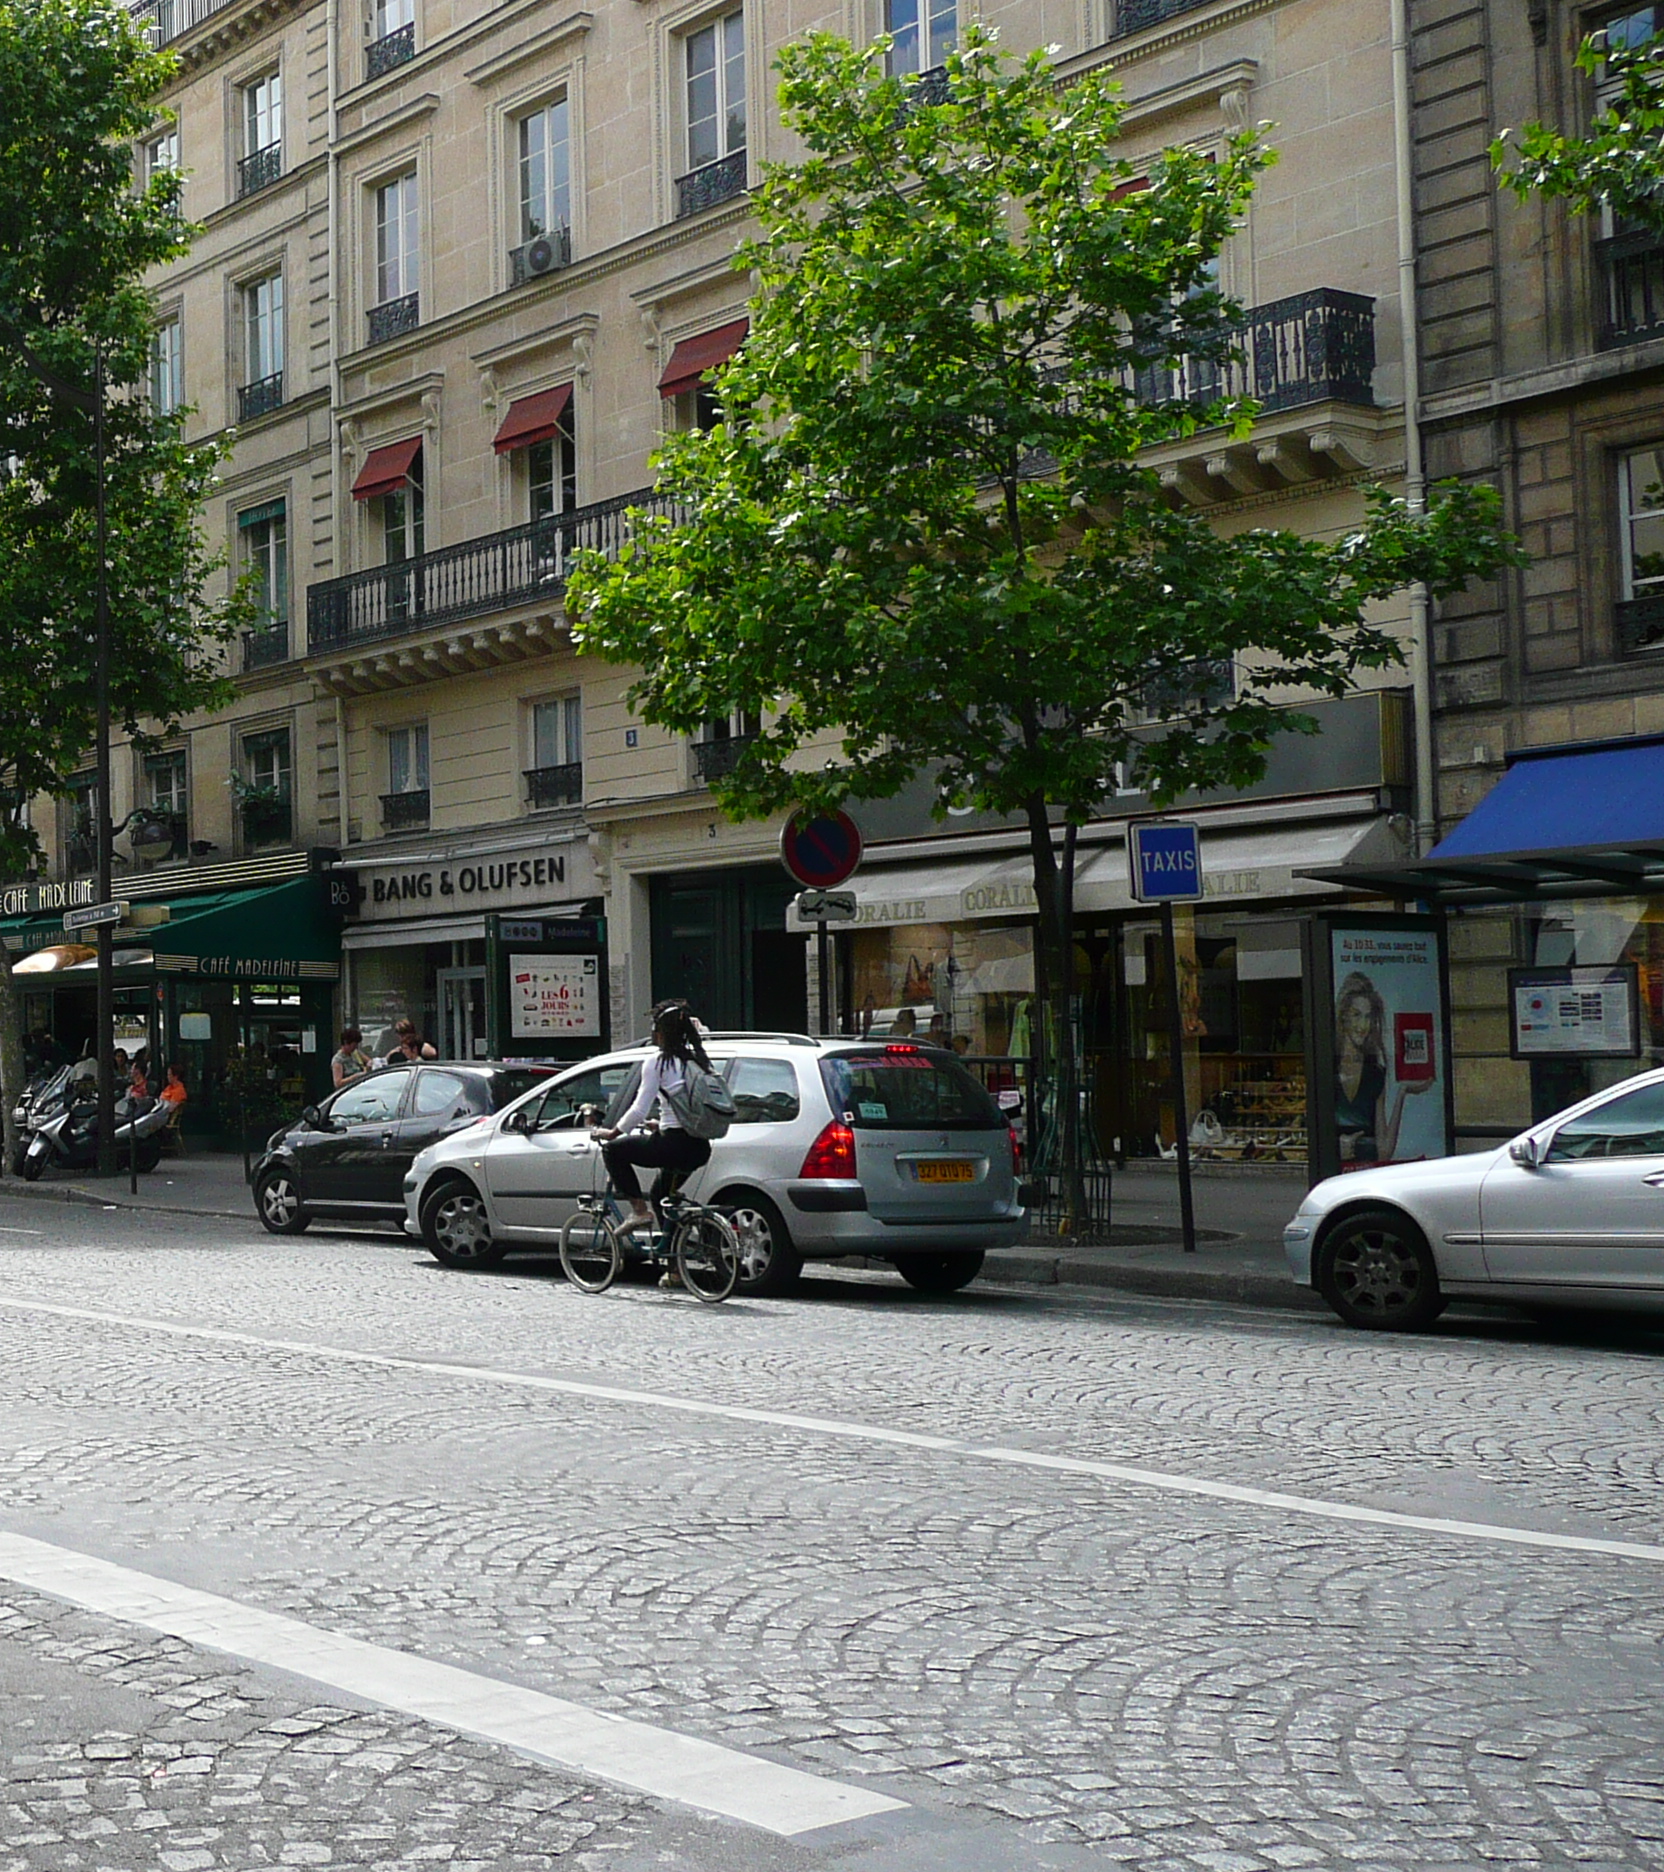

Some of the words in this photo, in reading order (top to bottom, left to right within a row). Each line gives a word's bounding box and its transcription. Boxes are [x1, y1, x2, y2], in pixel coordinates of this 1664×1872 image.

[628, 731, 635, 745] 3
[708, 823, 716, 838] 3
[1141, 850, 1196, 873] TAXIS
[373, 872, 433, 902] BANG
[439, 870, 454, 896] &
[458, 856, 565, 894] OLUFSEN
[1203, 870, 1261, 895] ALIE
[965, 878, 1036, 911] CORALI
[841, 900, 926, 924] ORALIE
[200, 956, 230, 974] CAFÉ
[235, 957, 297, 977] MADELEINE
[541, 990, 559, 1000] LES
[560, 984, 569, 1000] 6
[541, 1001, 570, 1011] JOURS
[918, 1163, 937, 1178] 327
[959, 1163, 973, 1178] 75
